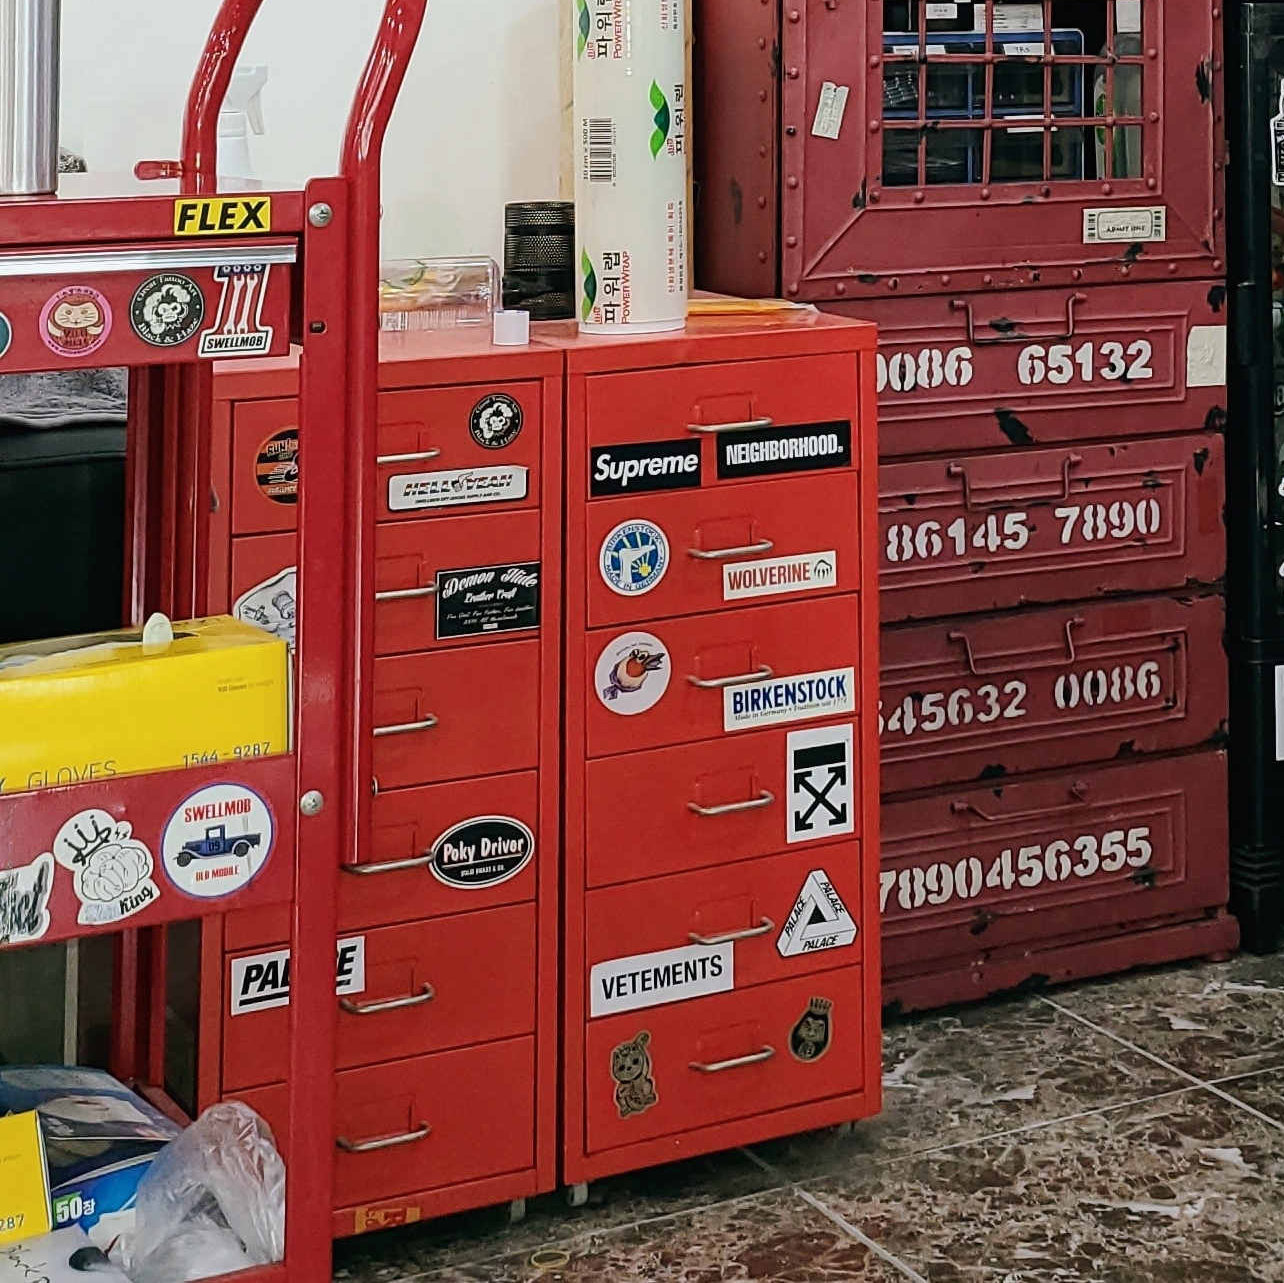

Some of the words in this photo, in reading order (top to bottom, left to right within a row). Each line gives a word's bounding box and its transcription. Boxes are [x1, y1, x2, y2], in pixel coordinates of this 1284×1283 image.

[177, 200, 269, 232] FLEX
[186, 283, 199, 298] Art
[602, 251, 621, 324] 파워랩
[137, 322, 162, 343] Black
[206, 334, 263, 350] SWELLMOB
[1017, 340, 1153, 386] 65132
[594, 451, 698, 486] Supreme
[402, 481, 452, 497] HELL
[466, 474, 514, 491] YEAH
[885, 512, 1029, 562] 86145
[1055, 499, 1160, 544] 7890
[442, 570, 496, 598] Demon
[500, 568, 538, 588] Hide
[728, 562, 811, 591] WOLVERINE
[733, 674, 847, 715] BIRKENSTOCK
[879, 681, 1027, 737] 45632
[1055, 661, 1161, 709] 0086
[734, 713, 751, 721] Made
[760, 707, 788, 717] Germany
[184, 798, 252, 823] SWELLMOB
[443, 841, 476, 863] Poky
[480, 837, 525, 856] Driver
[212, 865, 240, 879] MOBILE
[879, 826, 1152, 912] 7890456355
[119, 885, 154, 916] King
[819, 880, 846, 915] PALACE
[784, 896, 808, 937] PALACE
[801, 934, 839, 951] PALACE
[601, 954, 723, 1000] VETEMENTS
